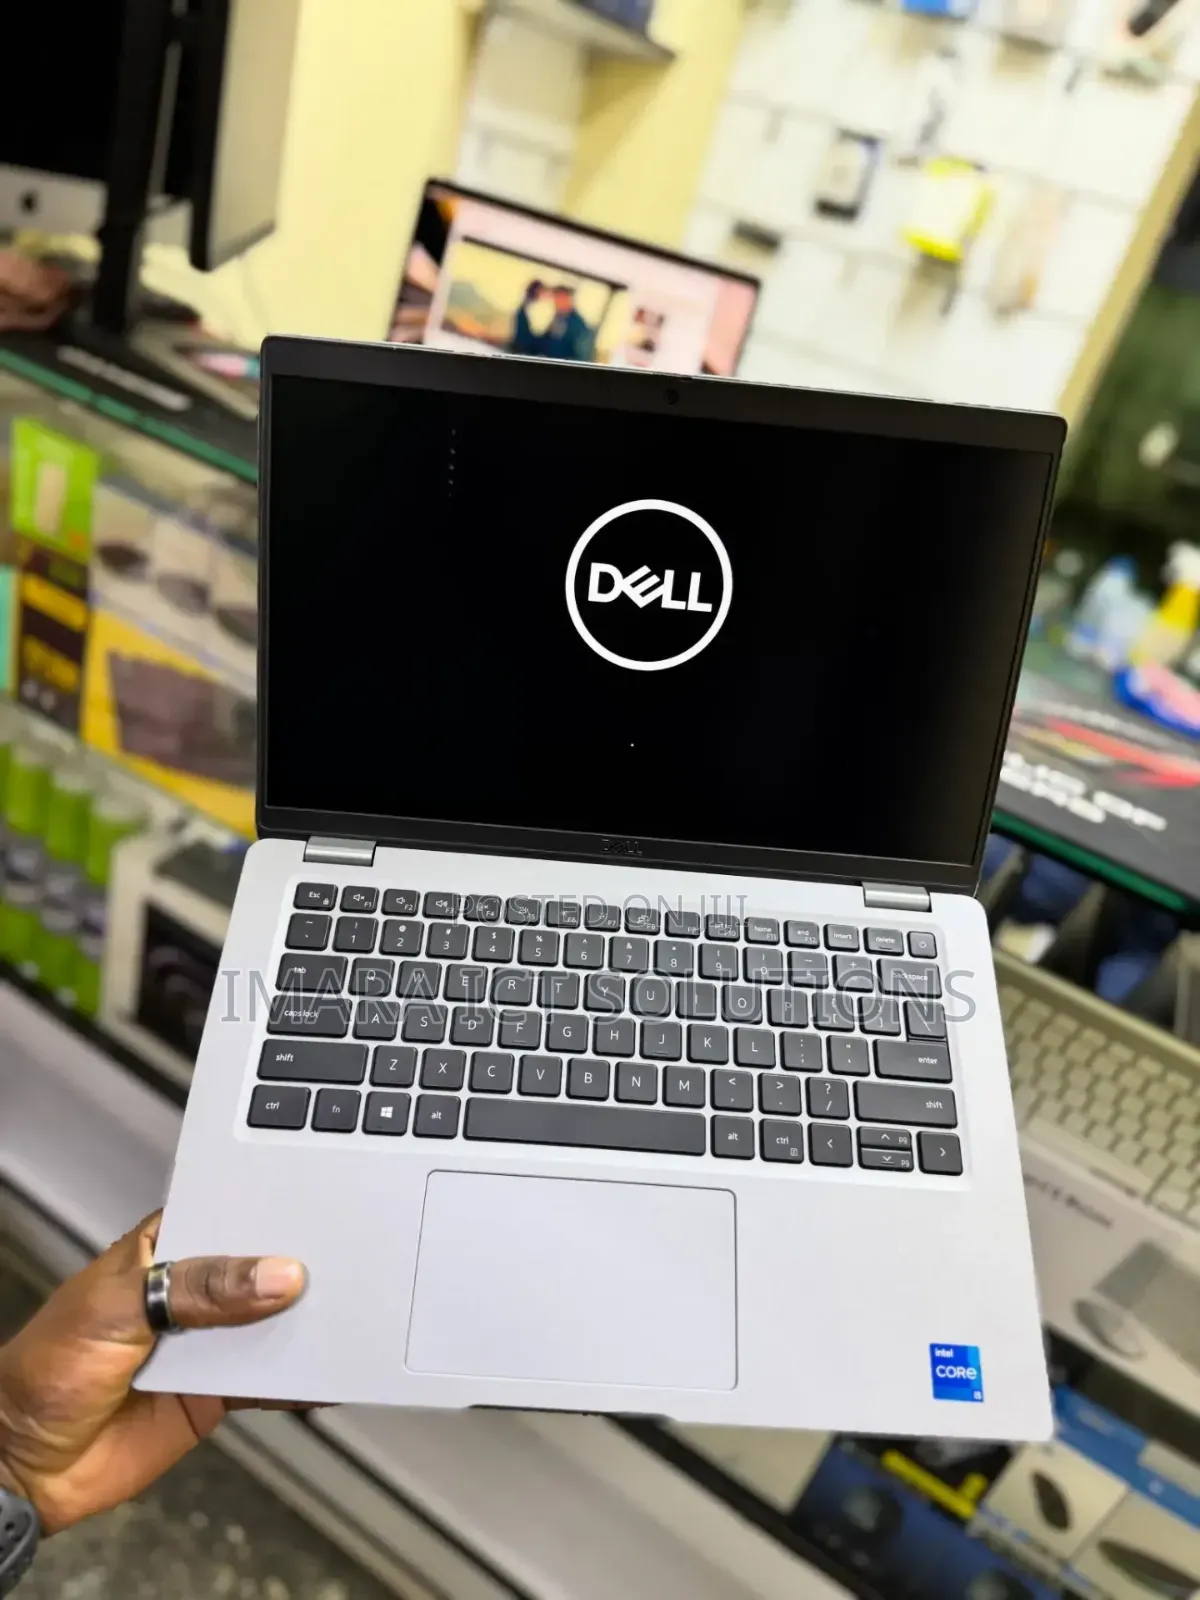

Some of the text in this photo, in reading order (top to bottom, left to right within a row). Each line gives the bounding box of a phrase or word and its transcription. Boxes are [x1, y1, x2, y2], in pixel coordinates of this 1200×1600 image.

[588, 562, 713, 612] DELL
[308, 891, 321, 899] Esc
[351, 934, 356, 944] 1
[834, 932, 852, 940] insert
[876, 936, 896, 944] delete
[396, 938, 404, 947] 2
[444, 941, 450, 950] 3
[490, 945, 496, 953] 4
[535, 948, 542, 957] 5
[580, 952, 588, 960] 6
[626, 955, 632, 964] 7
[670, 958, 678, 968] 8
[716, 962, 722, 972] 9
[294, 966, 306, 974] tab
[367, 970, 376, 981] Q
[462, 976, 469, 986] E
[508, 980, 516, 990] R
[555, 983, 562, 993] T
[600, 986, 609, 996] Y
[646, 990, 654, 1000] U
[738, 998, 747, 1008] O
[284, 1010, 302, 1018] caps
[372, 1014, 380, 1024] A
[420, 1016, 428, 1027] S
[468, 1020, 476, 1030] D
[516, 1022, 524, 1033] F
[562, 1026, 572, 1038] G
[610, 1030, 618, 1040] H
[658, 1034, 665, 1045] J
[704, 1038, 712, 1048] K
[752, 1042, 758, 1052] L
[276, 1053, 294, 1062] shift
[389, 1059, 398, 1070] Z
[438, 1062, 448, 1074] X
[487, 1066, 496, 1078] C
[536, 1069, 545, 1081] V
[584, 1072, 592, 1084] B
[632, 1076, 641, 1088] N
[679, 1080, 690, 1092] M
[266, 1102, 280, 1110] ctrl
[332, 1104, 340, 1113] fn
[925, 1100, 943, 1110] shift
[431, 1110, 442, 1120] alt
[728, 1132, 738, 1141] alt
[776, 1136, 789, 1145] ctrl
[934, 1347, 954, 1358] intel
